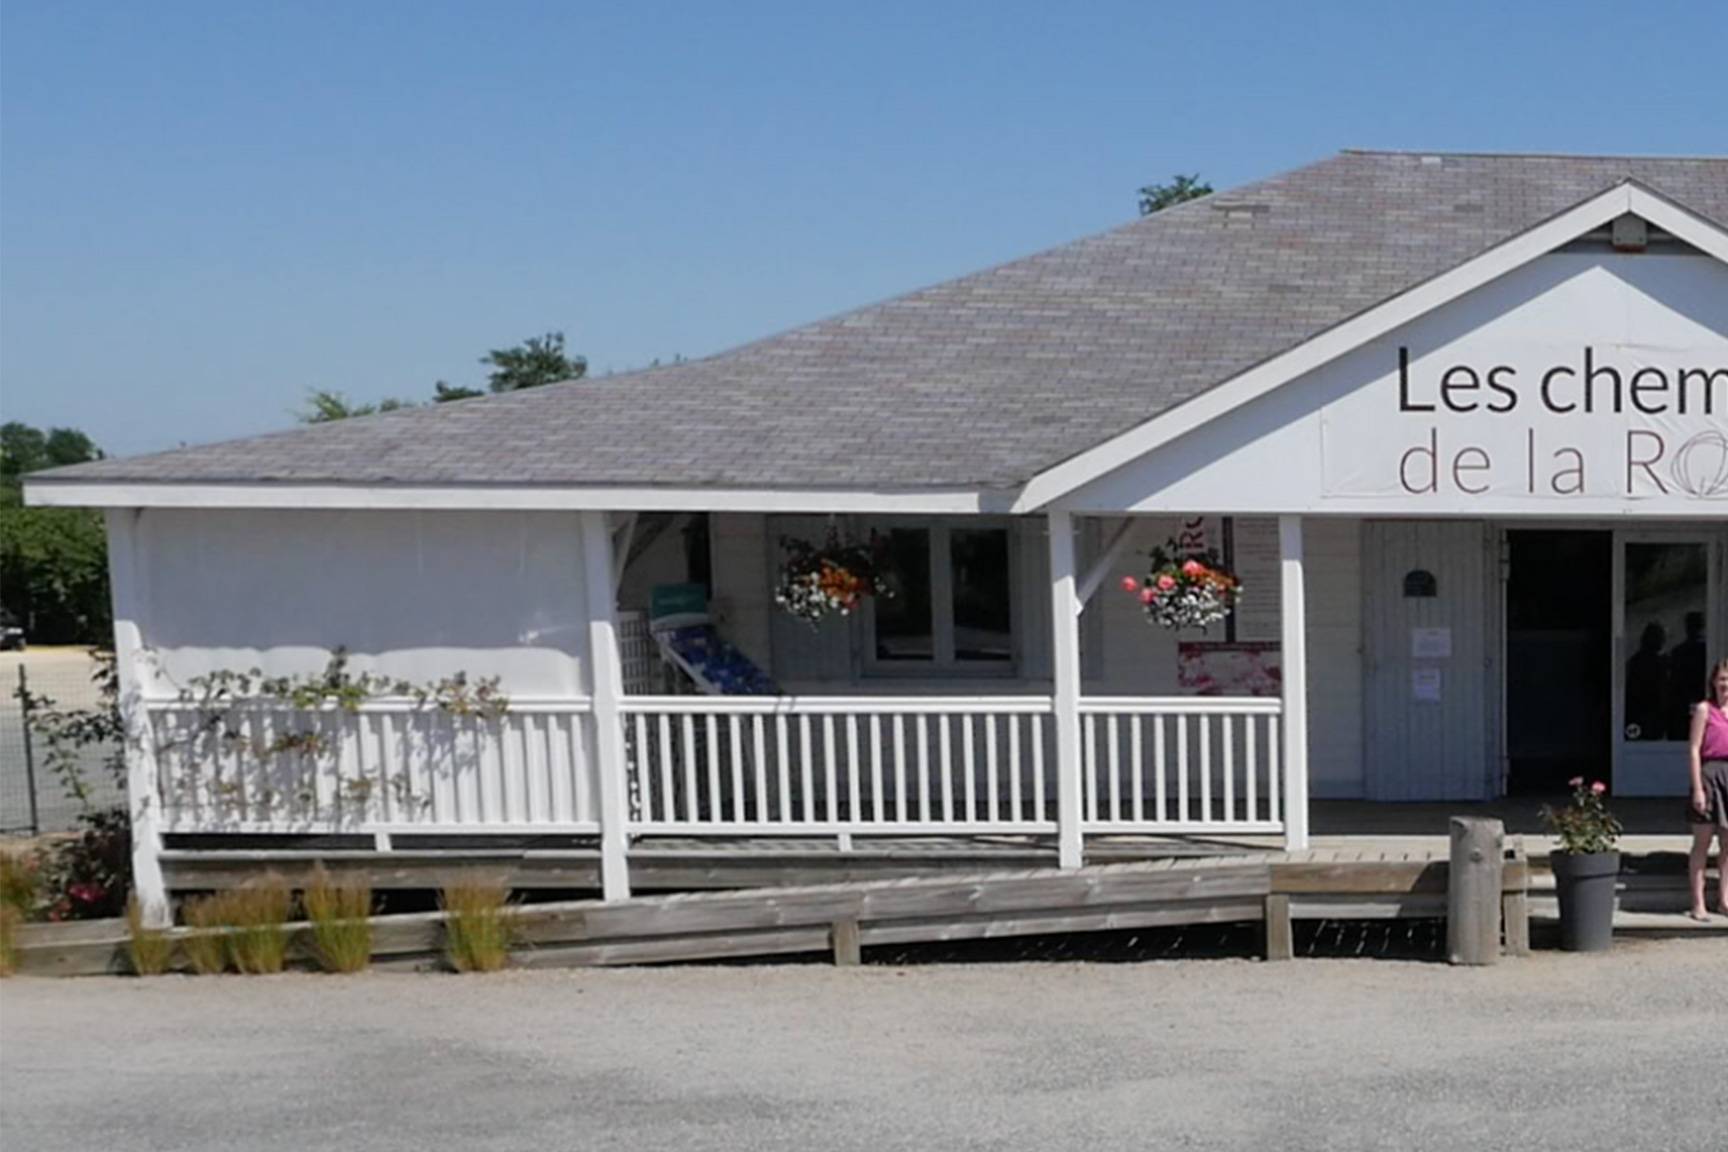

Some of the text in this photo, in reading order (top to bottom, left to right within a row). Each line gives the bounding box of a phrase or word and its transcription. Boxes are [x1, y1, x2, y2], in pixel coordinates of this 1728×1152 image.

[1399, 346, 1518, 413] Les
[1400, 427, 1490, 494] de
[1528, 427, 1584, 494] la
